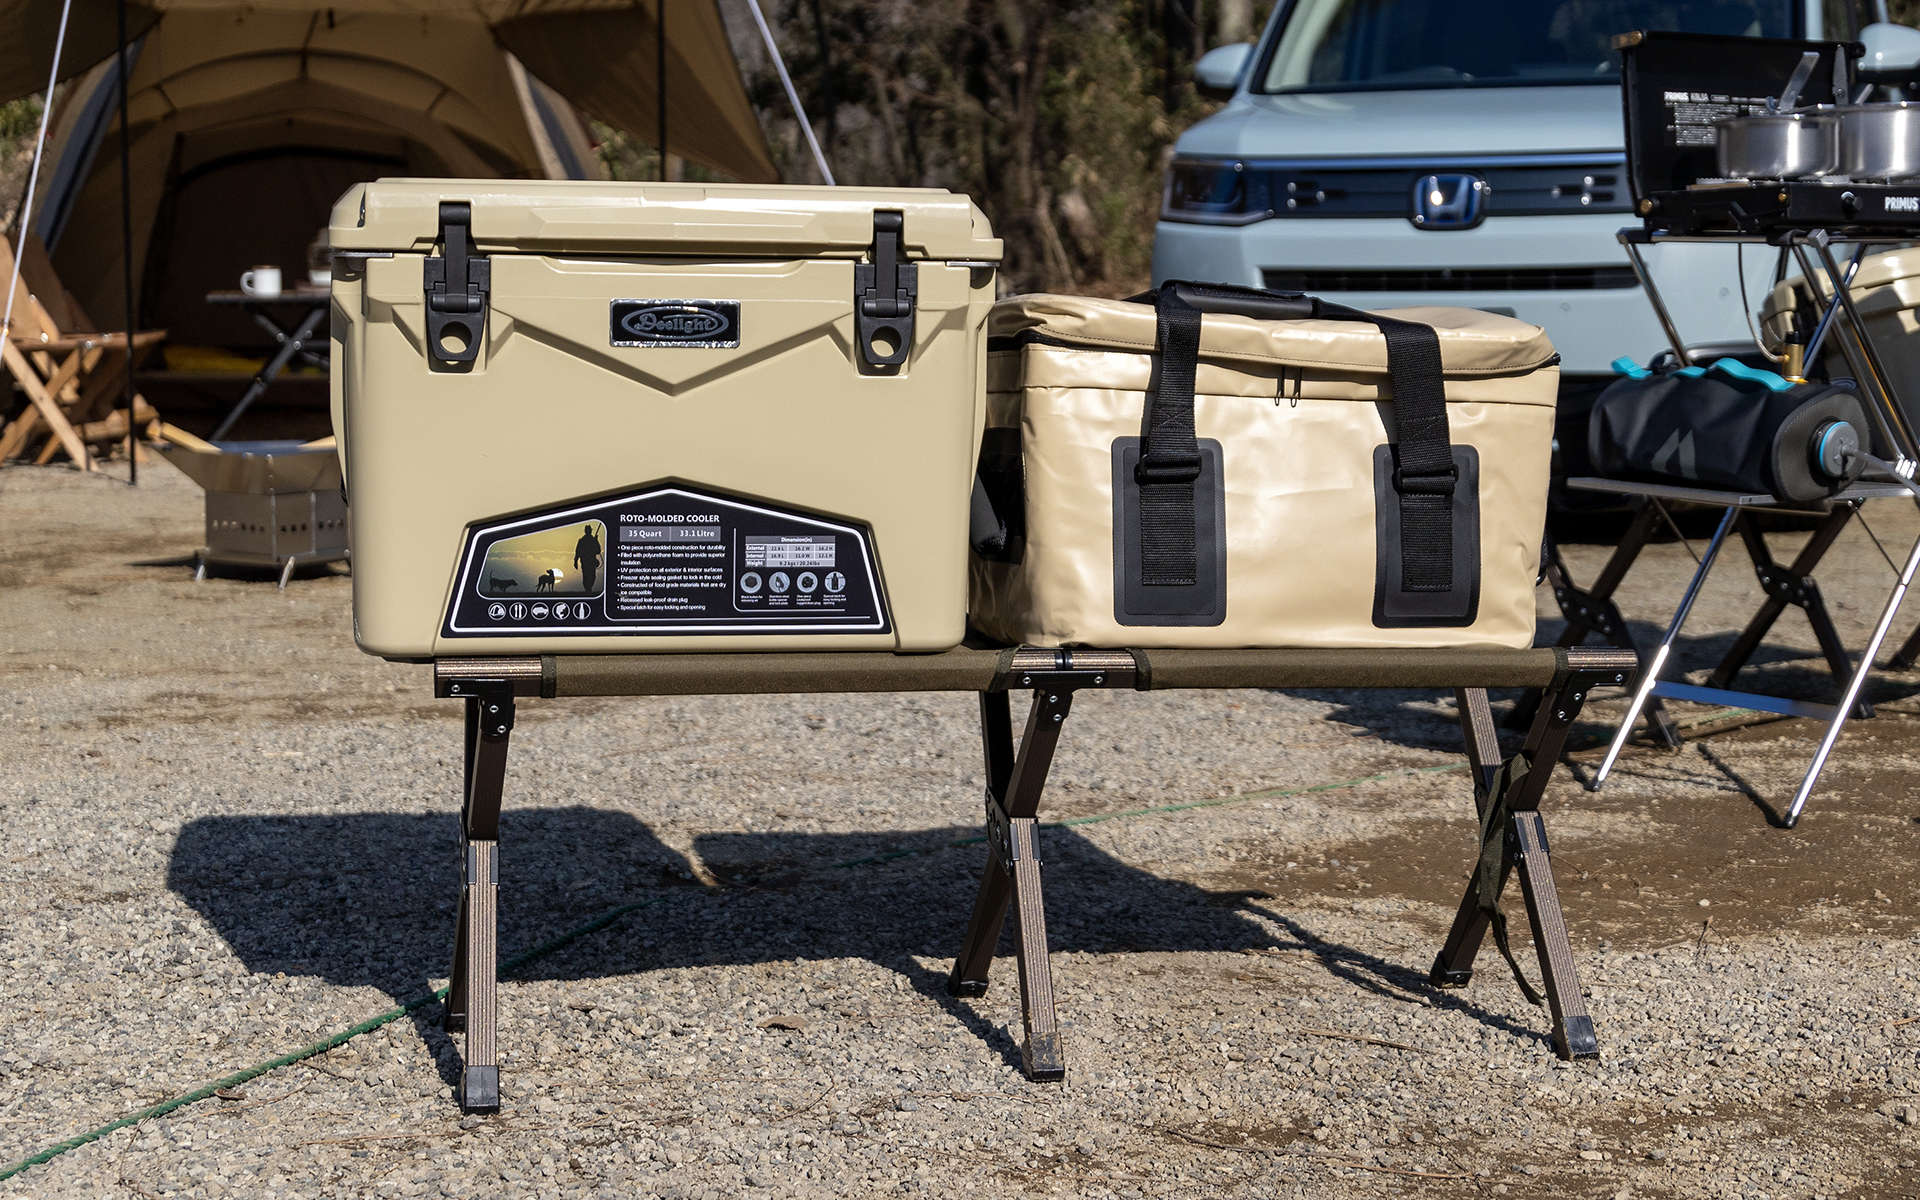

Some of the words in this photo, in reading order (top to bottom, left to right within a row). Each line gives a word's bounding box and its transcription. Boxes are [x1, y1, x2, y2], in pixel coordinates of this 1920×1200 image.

[1664, 92, 1689, 102] PRIMUS
[1884, 196, 1919, 212] PRIMUS
[634, 313, 718, 333] Deelight
[620, 514, 684, 522] ROTO-MOLDED
[686, 514, 720, 522] COOLER
[639, 530, 662, 539] Quart
